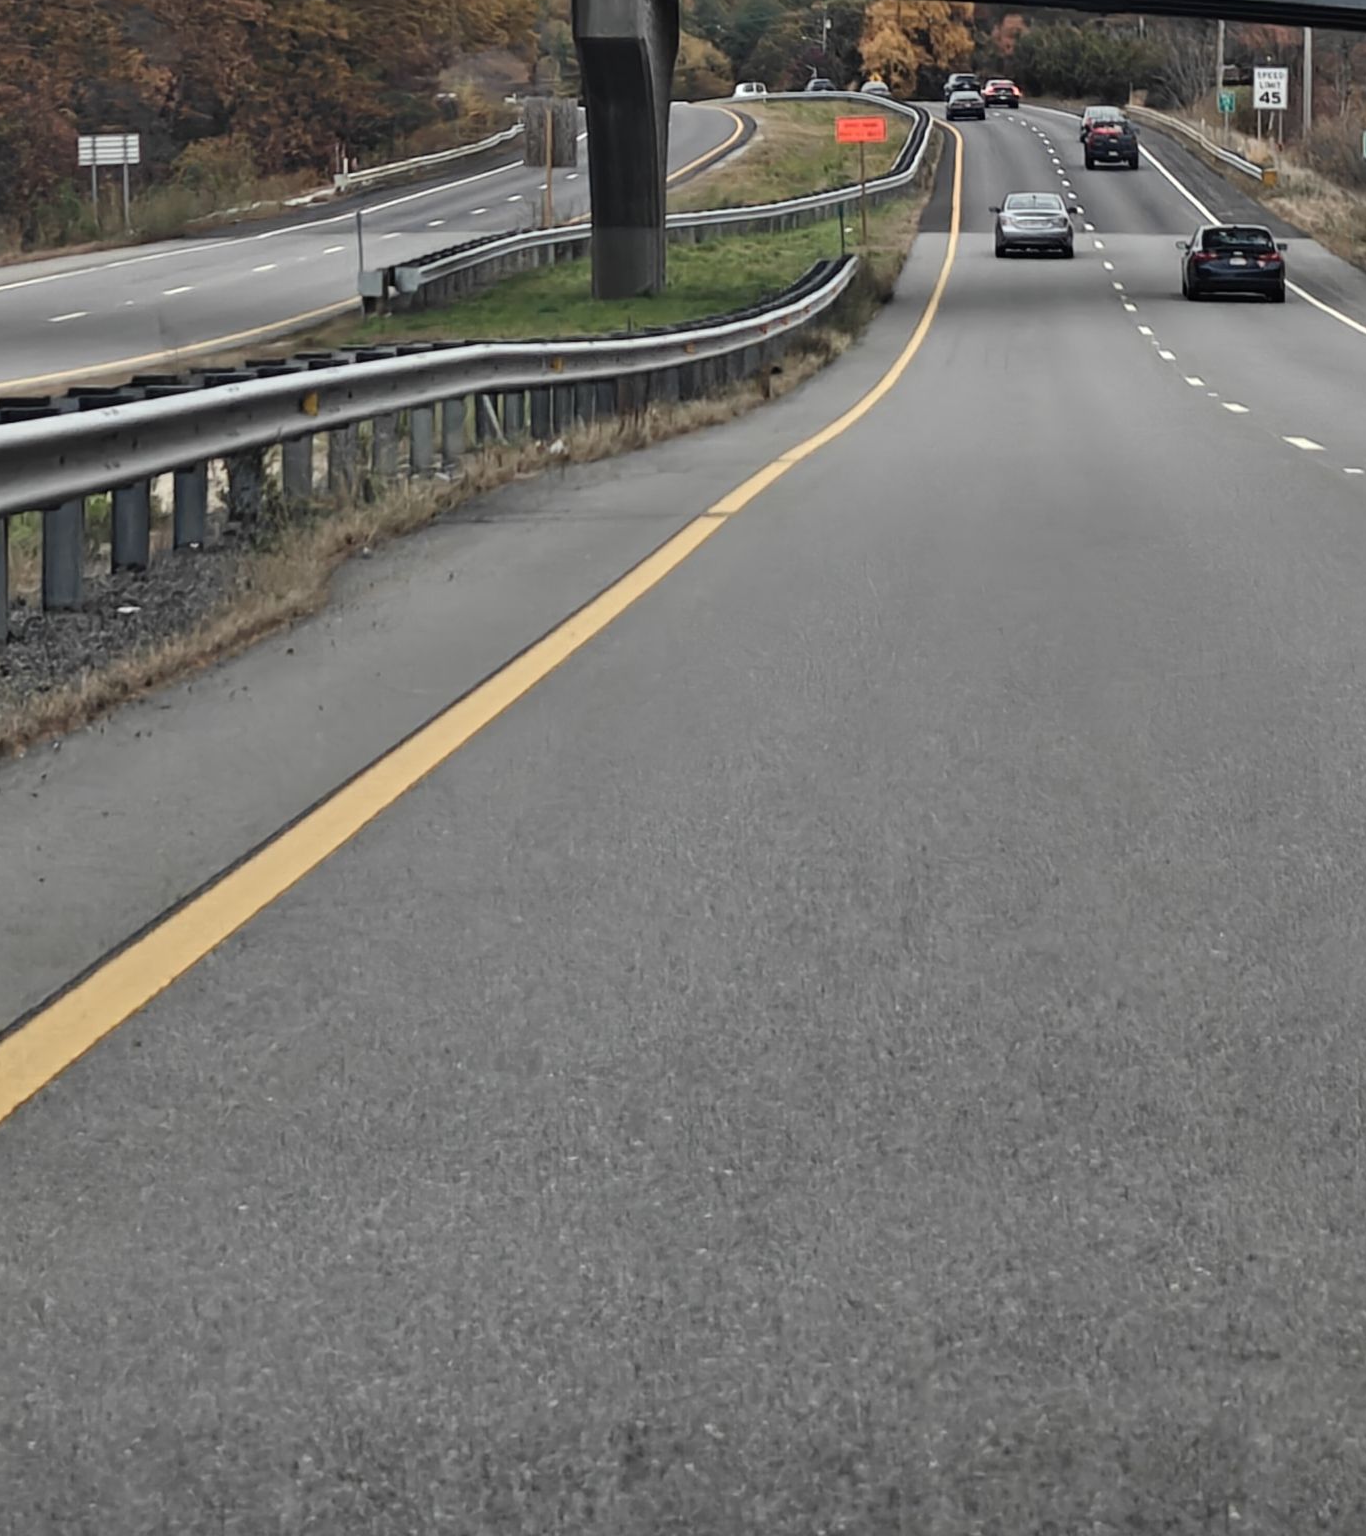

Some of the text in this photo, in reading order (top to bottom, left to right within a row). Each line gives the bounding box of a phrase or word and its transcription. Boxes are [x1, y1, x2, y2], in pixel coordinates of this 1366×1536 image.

[1257, 71, 1284, 80] SPEED
[1259, 81, 1281, 89] LIMIT
[1259, 91, 1282, 105] 45
